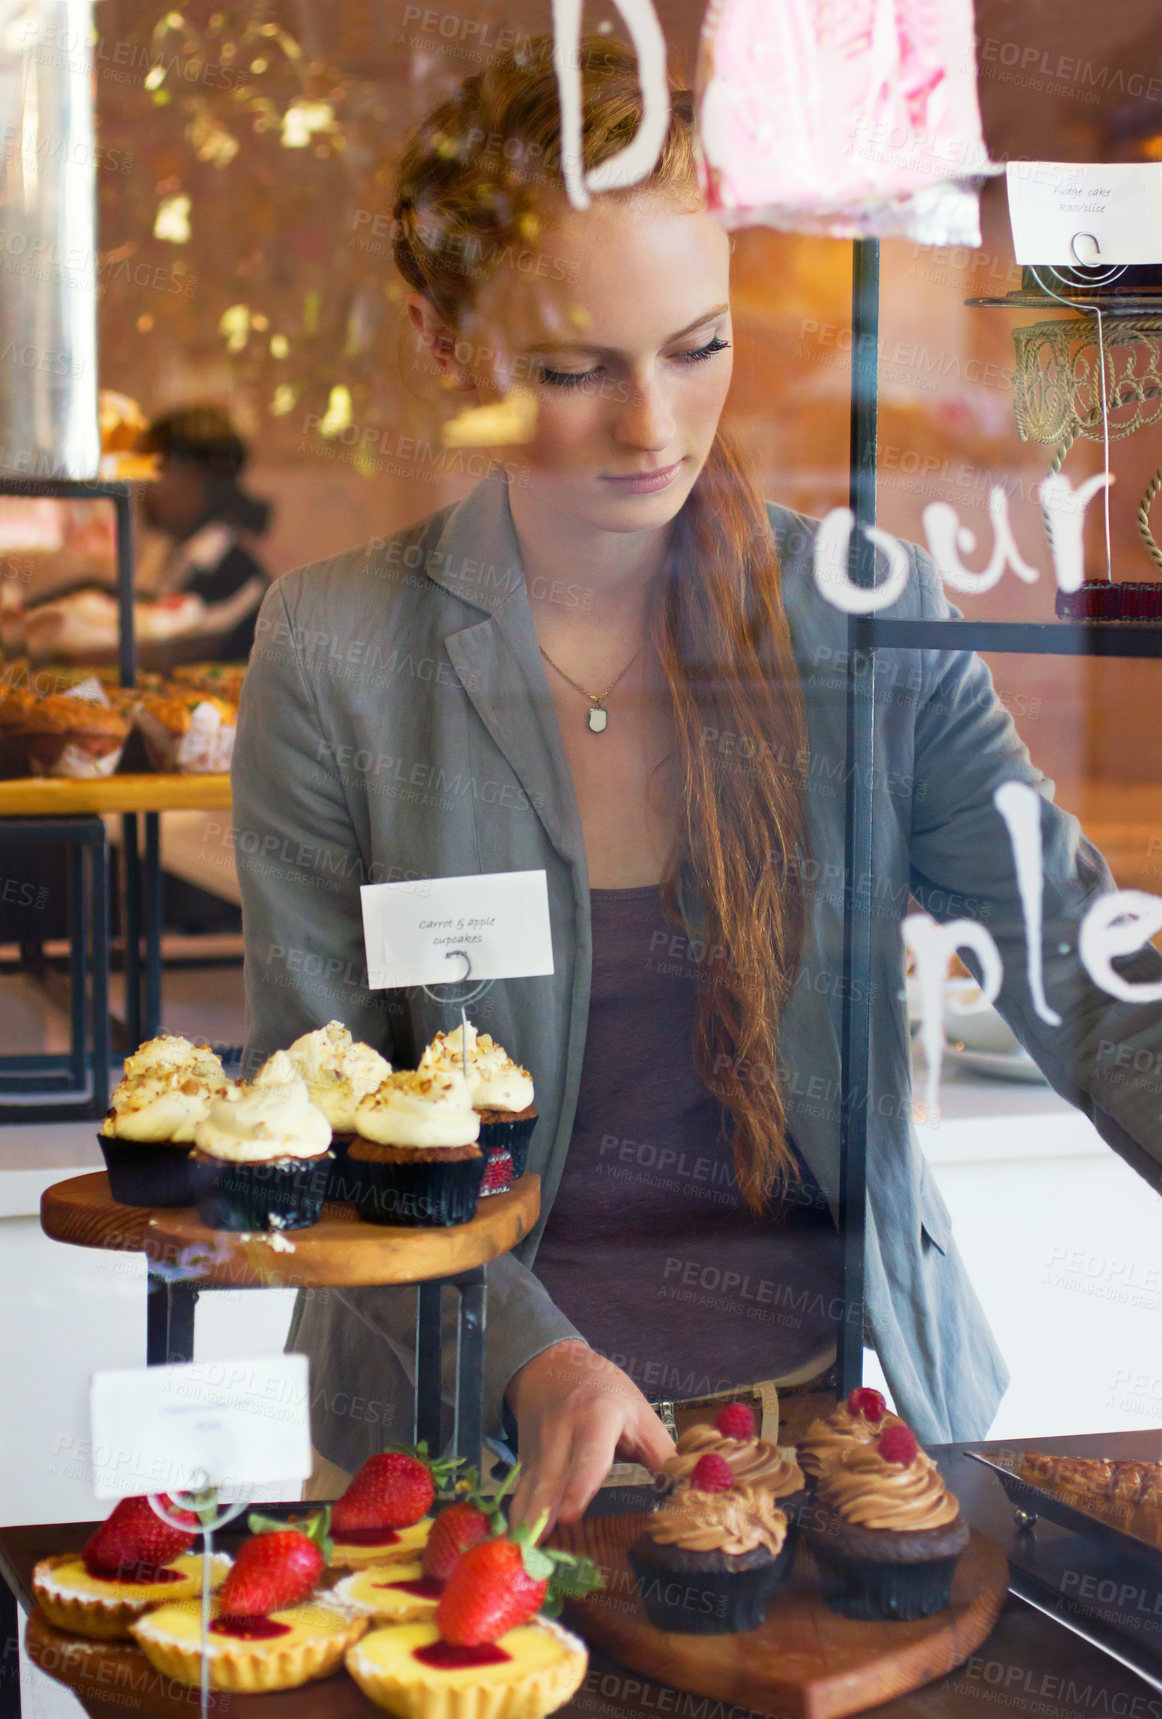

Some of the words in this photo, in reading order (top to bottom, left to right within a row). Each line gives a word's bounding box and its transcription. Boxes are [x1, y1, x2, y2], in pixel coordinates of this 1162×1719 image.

[1088, 187, 1112, 197] cake
[814, 472, 1116, 614] our
[467, 916, 496, 930] apple
[433, 934, 483, 947] cupcakes
